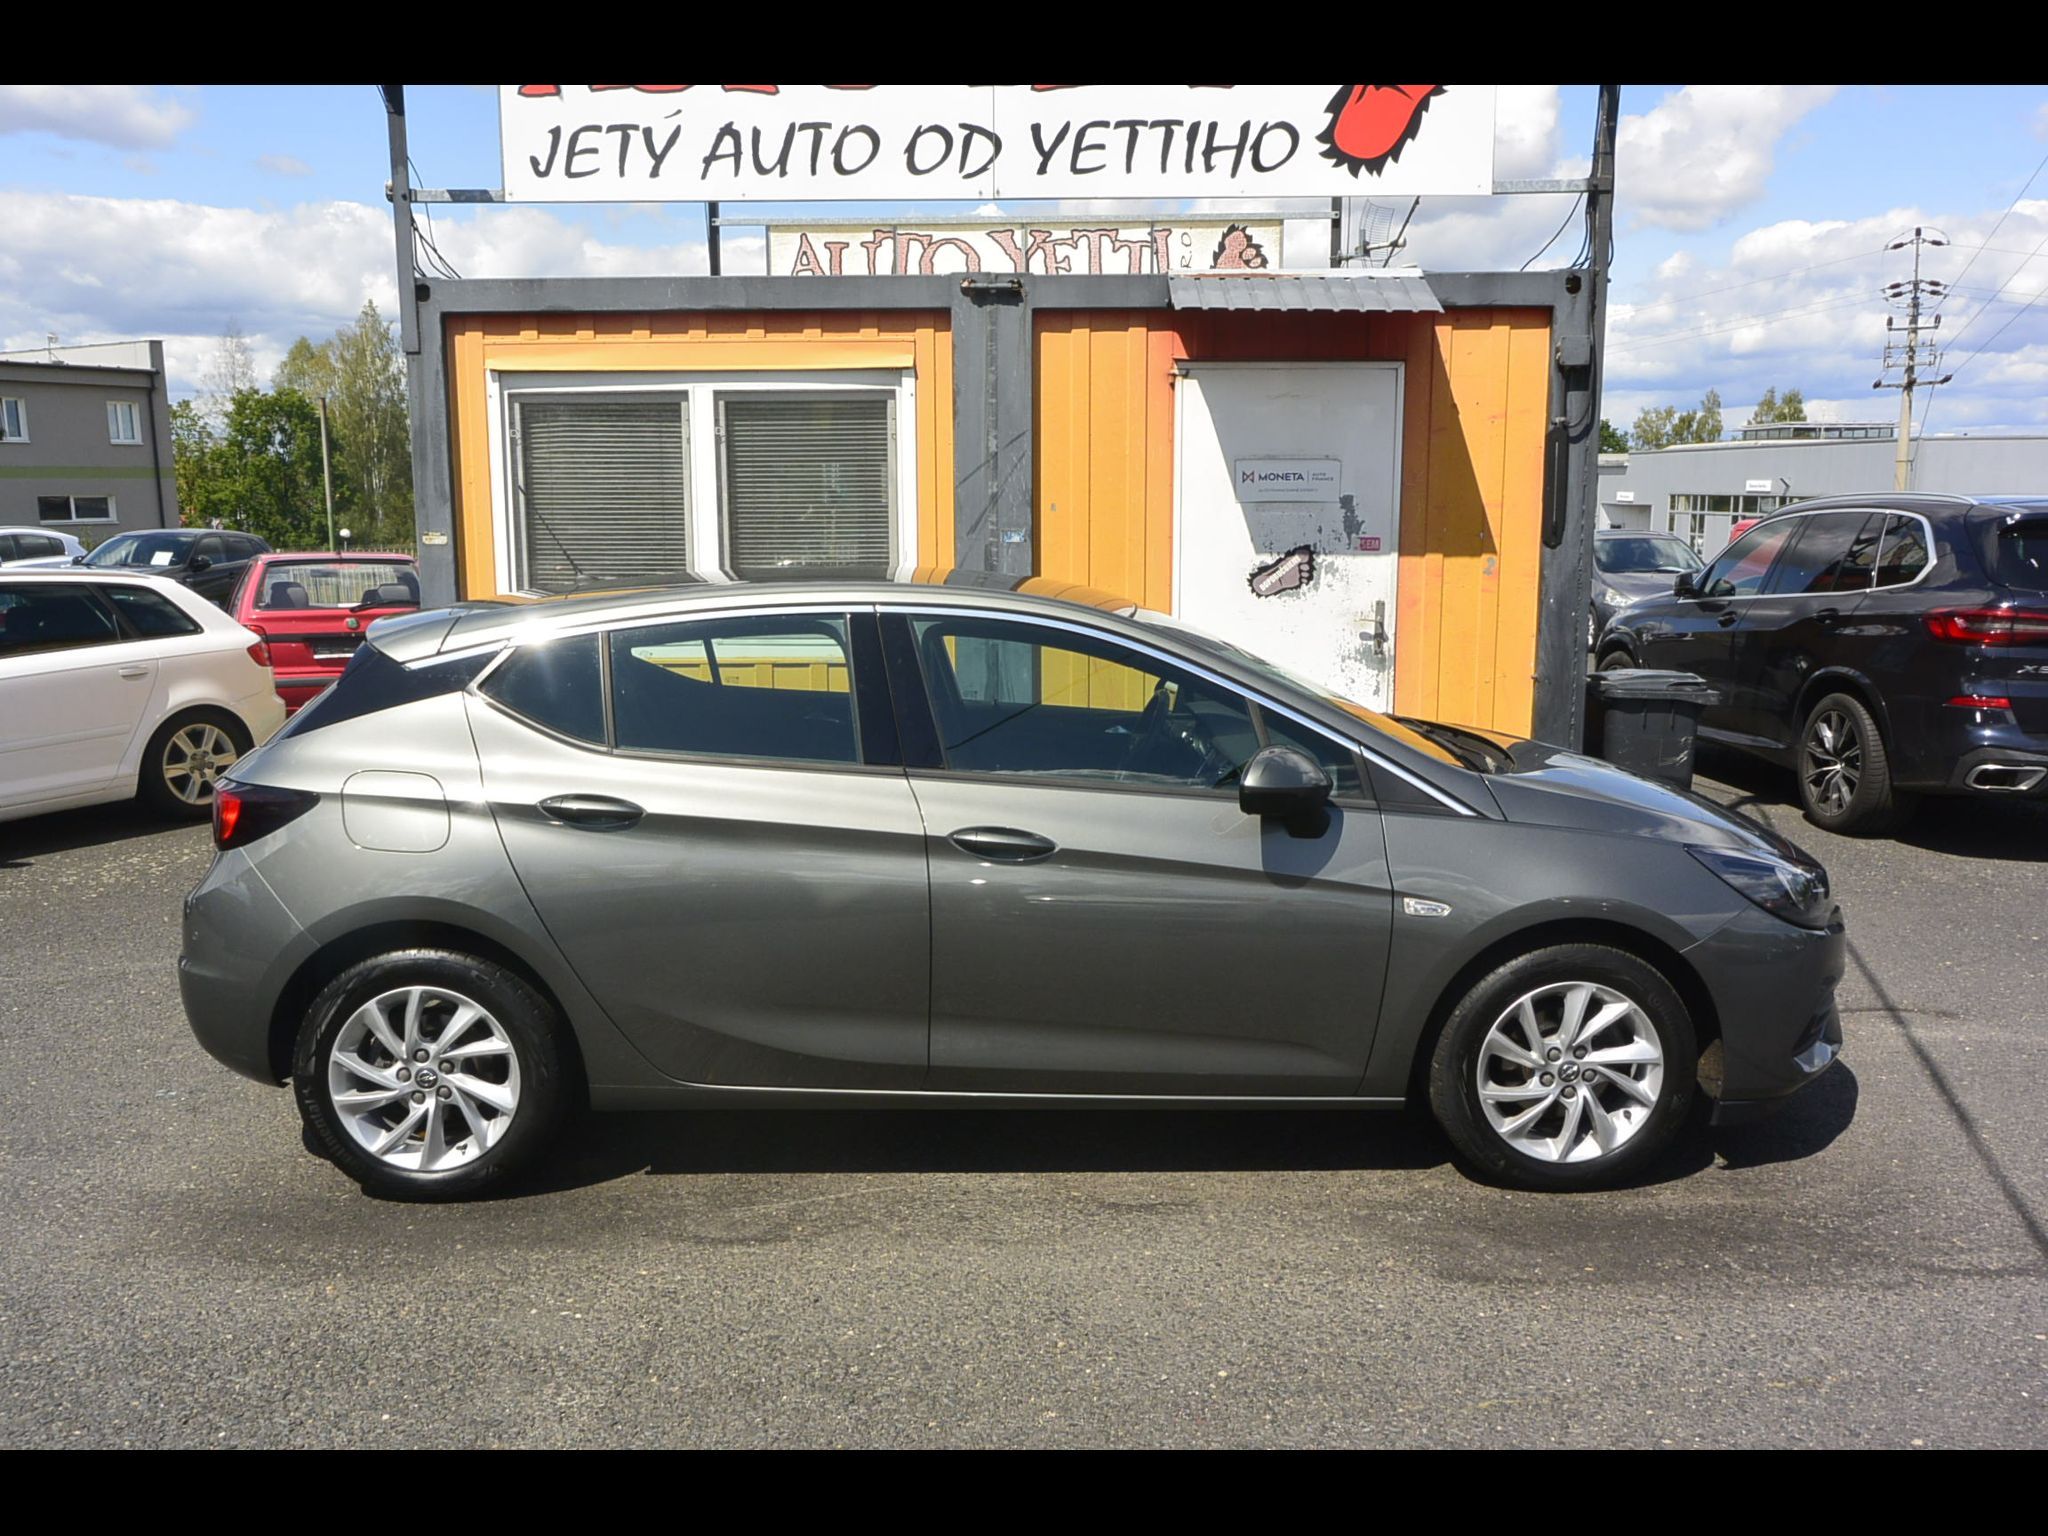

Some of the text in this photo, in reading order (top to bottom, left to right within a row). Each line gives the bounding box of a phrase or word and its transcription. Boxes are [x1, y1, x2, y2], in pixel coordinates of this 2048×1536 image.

[530, 109, 1300, 180] JETÝ AUTO OD YETTIHO
[1258, 472, 1305, 482] MONETA
